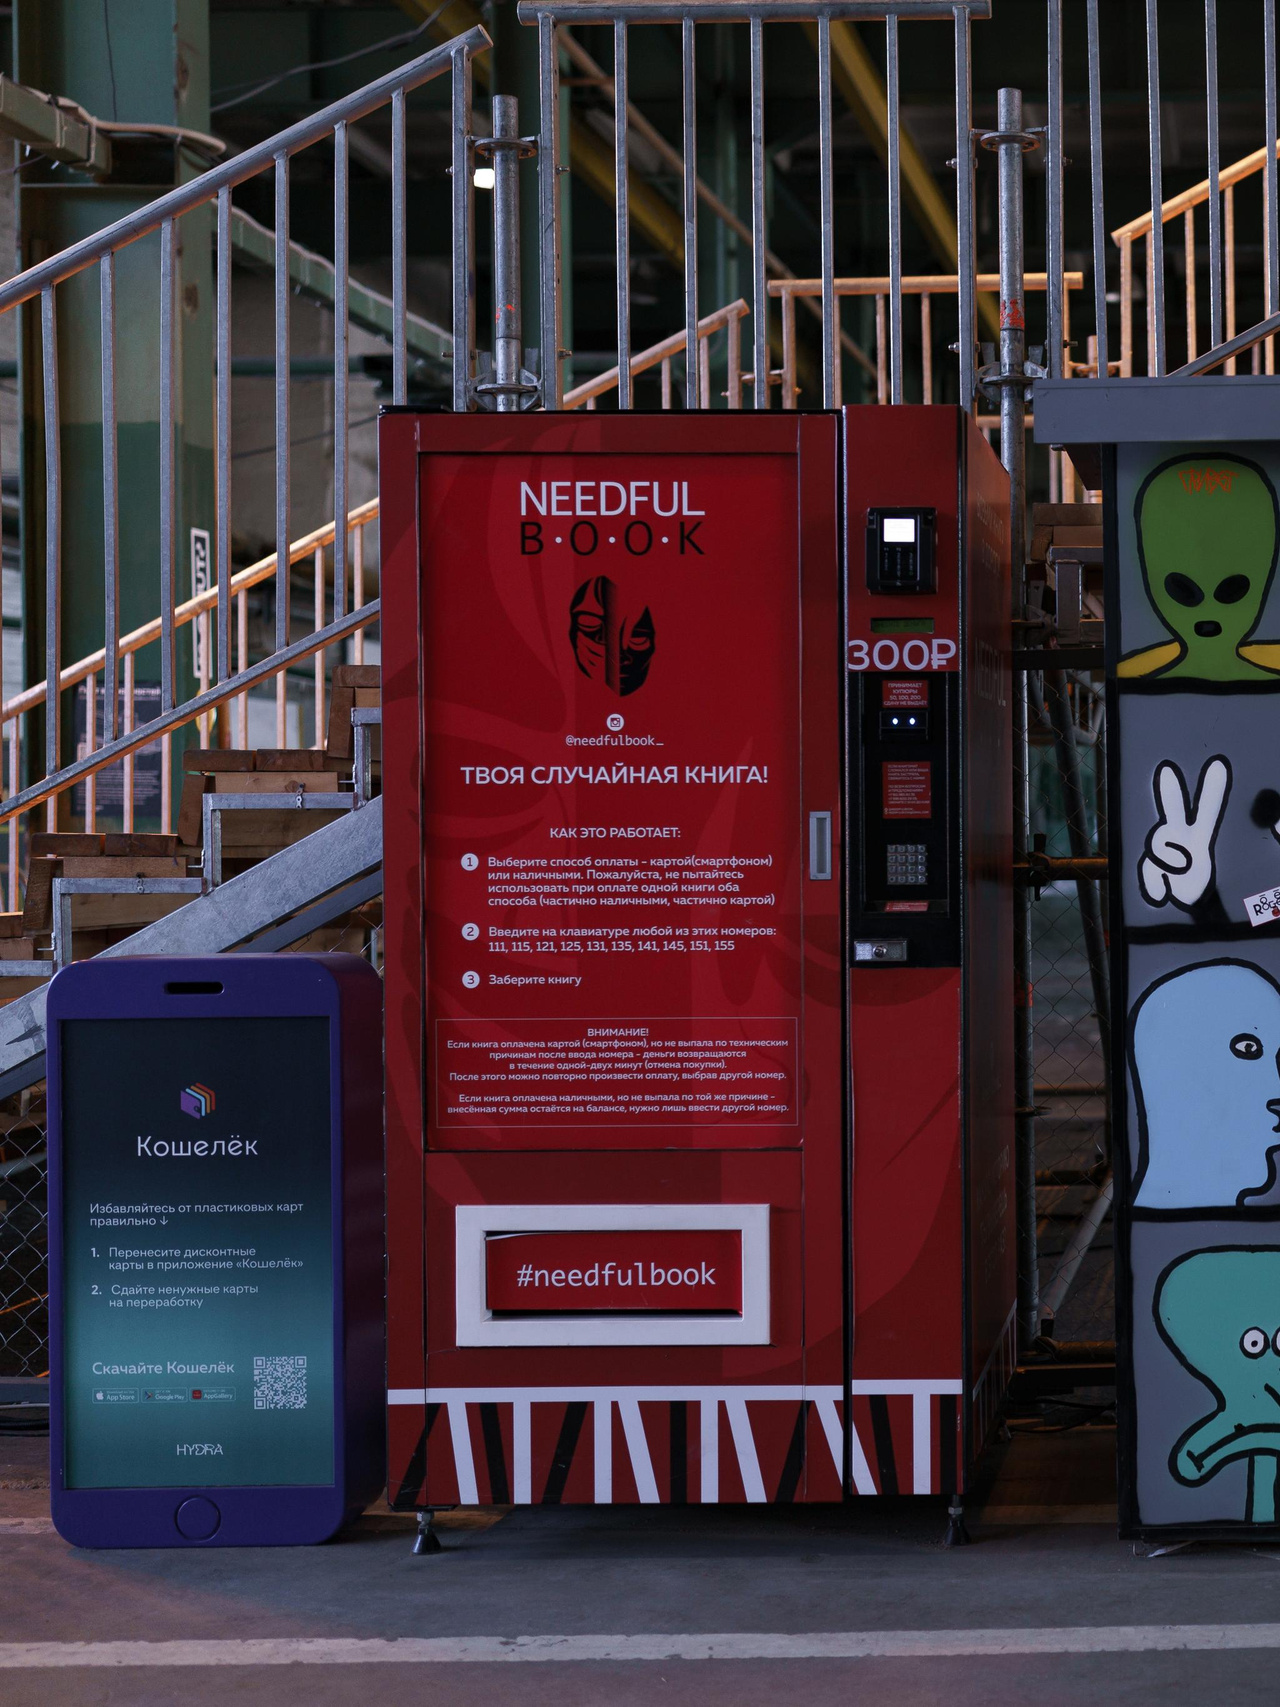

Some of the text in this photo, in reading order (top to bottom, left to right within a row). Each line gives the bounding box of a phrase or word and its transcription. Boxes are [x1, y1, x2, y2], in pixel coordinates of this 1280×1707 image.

[520, 481, 705, 517] NEEDFUL
[566, 734, 664, 746] @needfulbook_
[460, 762, 768, 784] ТВОЯ СЛУЧАЙНАЯ КНИГА!
[550, 827, 681, 838] КАК ЭТО РАБОТАЕТ:
[466, 854, 772, 869] 1 Выберите способ оплаты картой(смартфоном)
[488, 869, 744, 882] или наличными. Пожалуйста, не пытайтесь
[488, 882, 740, 895] использовать при оплате одной книги оба
[488, 894, 775, 907] способа (частично наличными, частично картой)
[466, 926, 776, 939] 2 Введите на клавиатуре любой из этих номеров:
[488, 940, 735, 953] 111, 115, 121, 125, 131, 135, 141, 145, 151, 155
[467, 974, 582, 987] 3 Заберите книгу
[587, 1028, 649, 1036] ВНИМАНИЕ!
[447, 1040, 470, 1048] Если
[547, 1040, 580, 1050] картой
[582, 1038, 649, 1049] (смартфоном),
[489, 1052, 536, 1060] причинам
[598, 1052, 634, 1060] номера
[642, 1051, 676, 1059] деньги
[677, 1051, 747, 1060] возвращаются
[556, 1061, 612, 1071] одной-двух
[614, 1062, 643, 1071] минут
[644, 1060, 681, 1070] (отмена
[683, 1059, 727, 1070] покупки).
[450, 1072, 479, 1081] После
[542, 1074, 588, 1082] повторно
[589, 1073, 644, 1082] произвести
[645, 1073, 680, 1082] оплату,
[682, 1071, 718, 1081] выбрав
[719, 1071, 753, 1081] другой
[754, 1072, 786, 1080] номер.
[459, 1094, 482, 1102] Если
[695, 1092, 712, 1101] той
[728, 1094, 769, 1102] причине
[448, 1105, 497, 1113] внесённая
[498, 1106, 528, 1115] сумма
[530, 1104, 571, 1113] остаётся
[586, 1104, 627, 1113] балансе,
[629, 1105, 660, 1114] нужно
[721, 1103, 755, 1114] другой
[757, 1104, 789, 1113] номер.
[138, 1135, 258, 1157] Кошелёк
[90, 1203, 304, 1214] Избавляйтесь от пластиковых карт
[90, 1218, 156, 1228] правильно
[91, 1247, 256, 1259] 1. Перенесите дисконтные
[109, 1258, 304, 1272] карты приложение «Кошелёк»
[517, 1262, 716, 1287] #needfulbook
[91, 1284, 258, 1296] 2. Сдайте ненужные карты
[109, 1296, 204, 1309] на переработку
[92, 1361, 234, 1375] Скачайте Кошелёк
[106, 1394, 119, 1402] App
[176, 1444, 224, 1456] HYDRA
